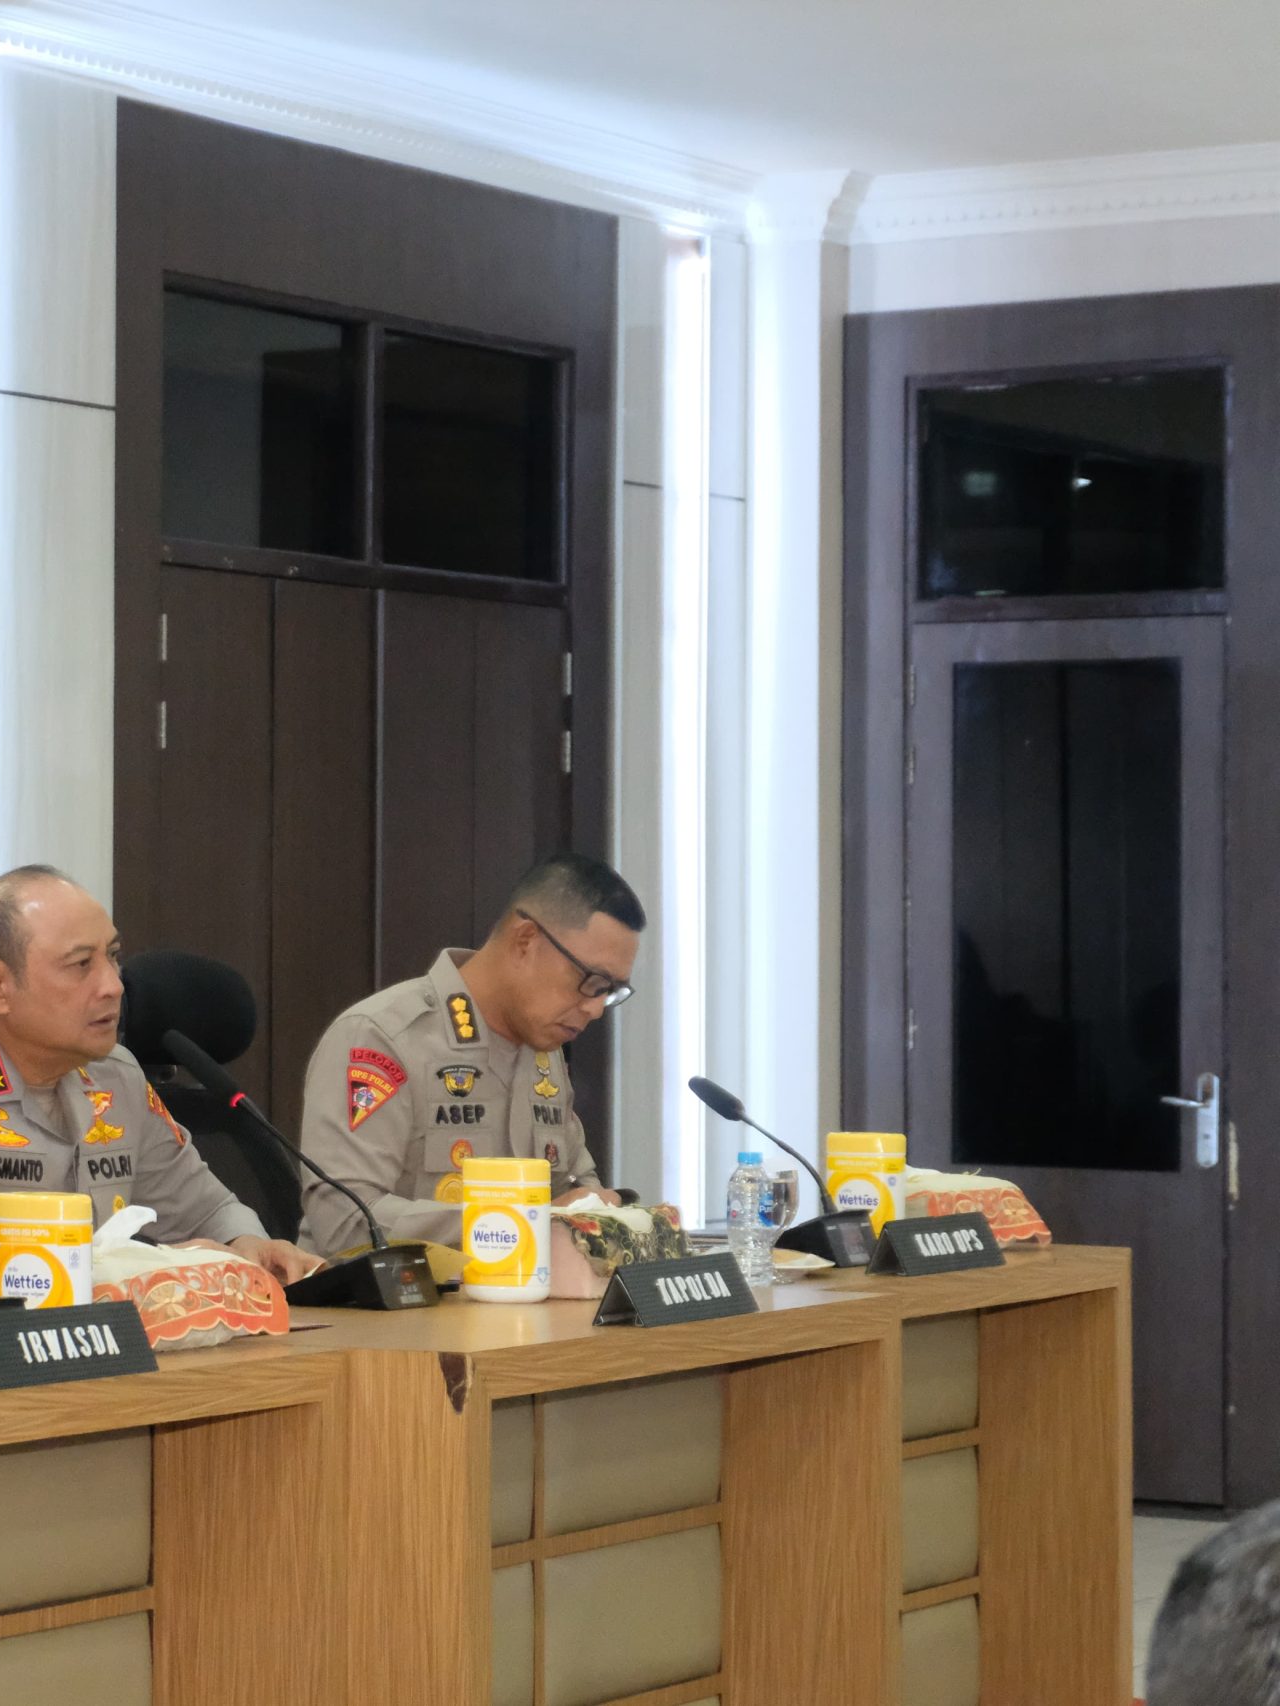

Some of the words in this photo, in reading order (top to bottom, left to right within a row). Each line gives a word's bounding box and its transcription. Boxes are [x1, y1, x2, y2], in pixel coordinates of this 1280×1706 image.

[351, 1069, 369, 1079] OPS
[353, 1050, 404, 1083] PELOPOR
[435, 1104, 486, 1125] ASEP
[87, 1154, 133, 1181] POLRI
[838, 1194, 879, 1207] Wetties
[473, 1229, 518, 1243] Wetties
[914, 1231, 955, 1258] KARO
[952, 1228, 984, 1253] OPS
[4, 1273, 51, 1289] Wetties
[17, 1324, 121, 1364] IRWASDA
